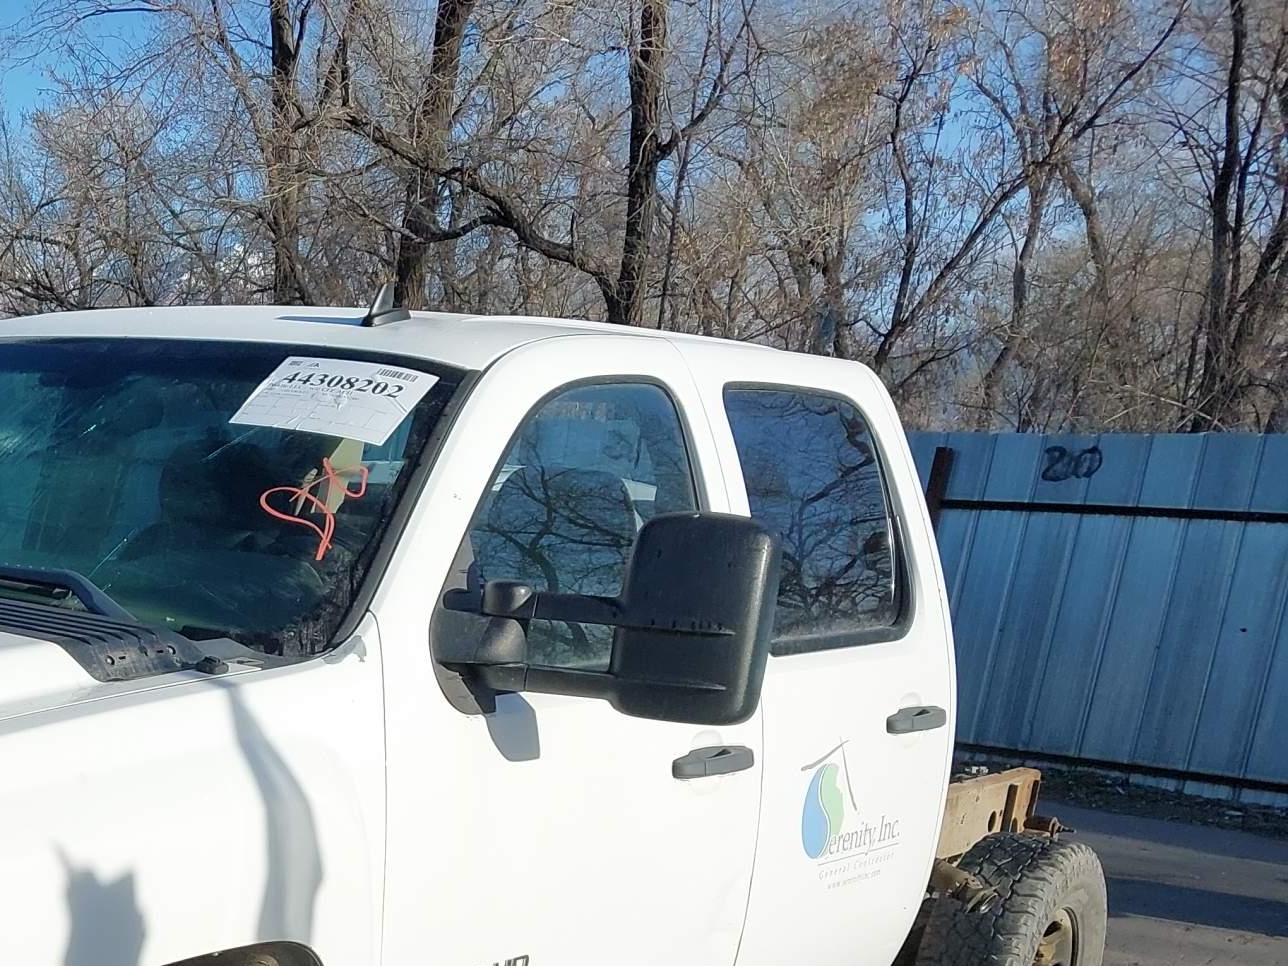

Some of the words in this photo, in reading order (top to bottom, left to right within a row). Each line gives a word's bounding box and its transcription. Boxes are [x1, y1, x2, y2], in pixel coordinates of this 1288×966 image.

[282, 371, 404, 399] 44308202
[1042, 446, 1103, 482] 20
[878, 815, 900, 842] Inc.
